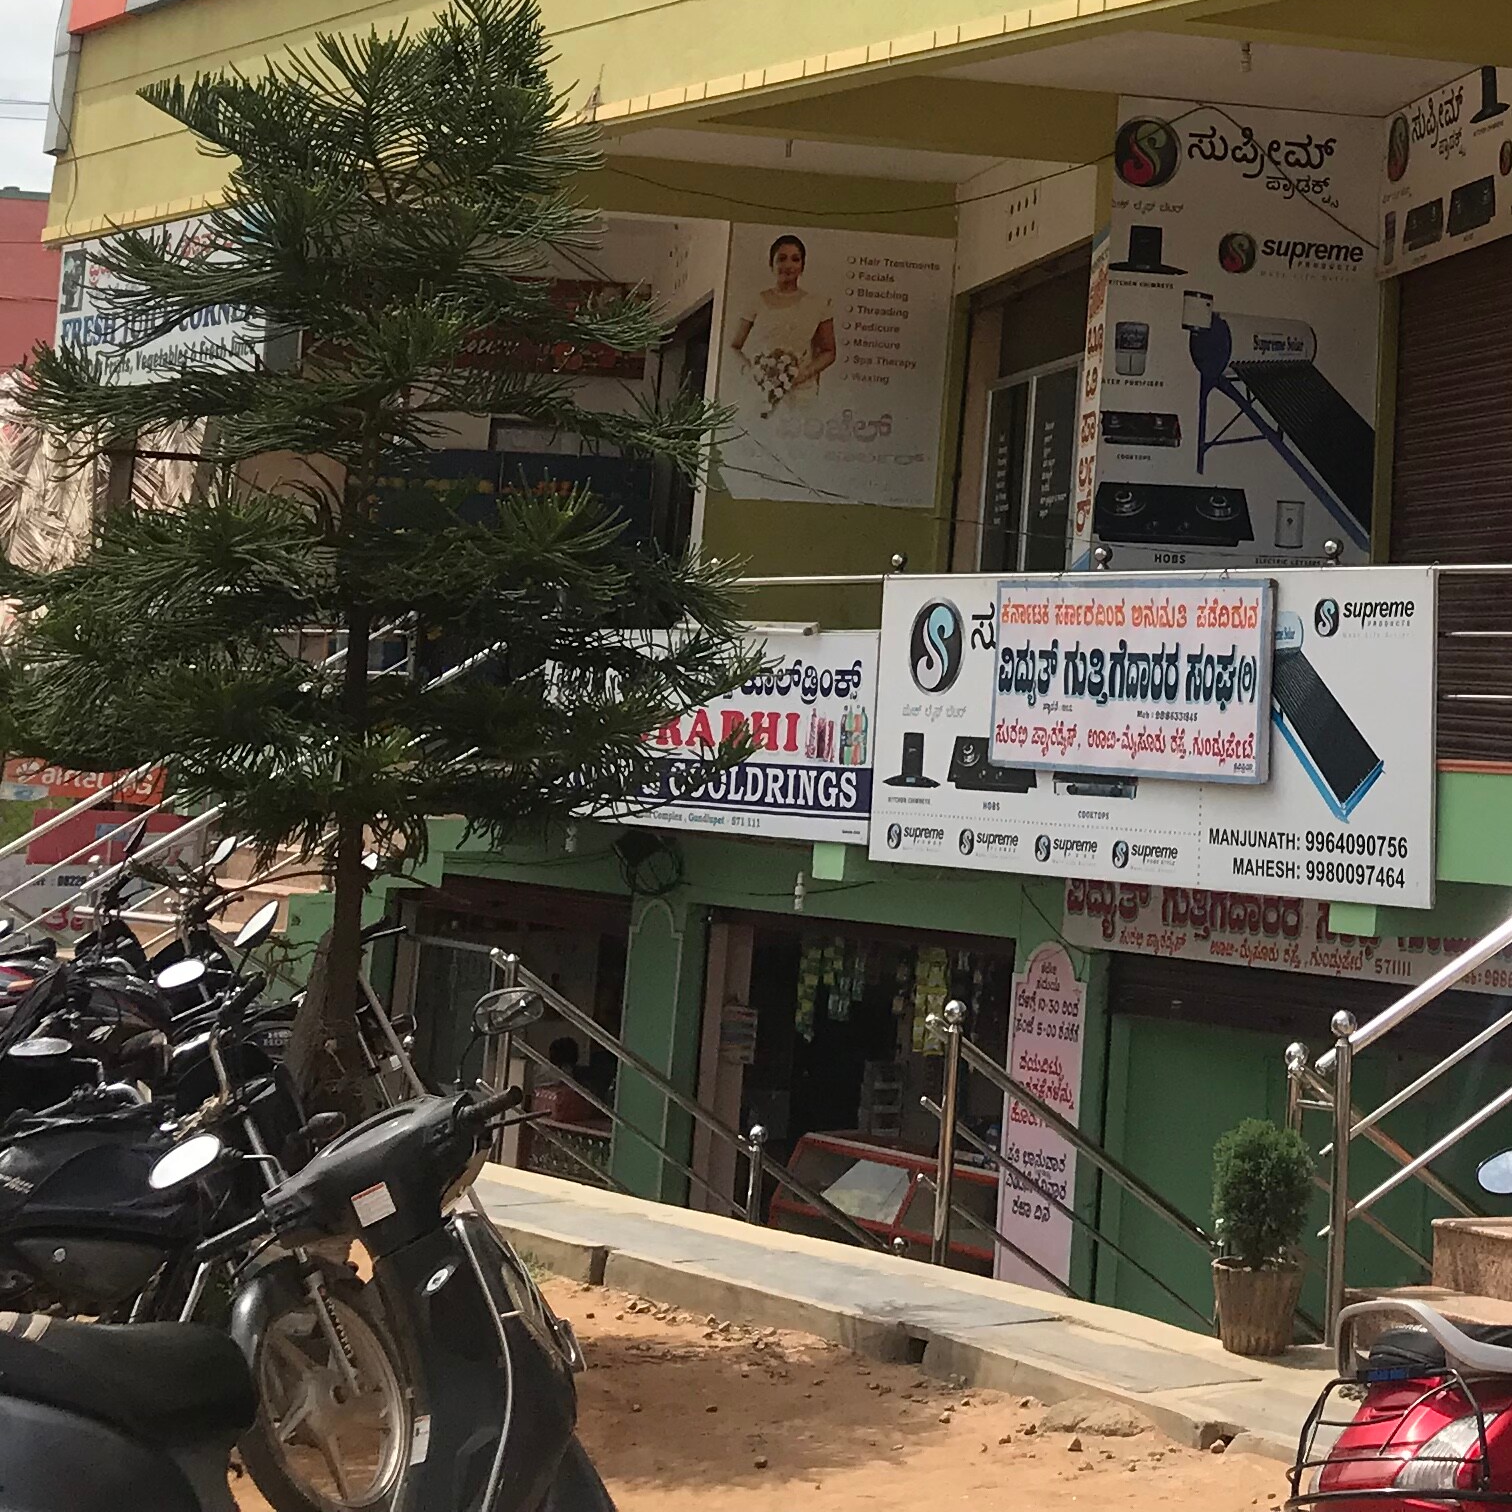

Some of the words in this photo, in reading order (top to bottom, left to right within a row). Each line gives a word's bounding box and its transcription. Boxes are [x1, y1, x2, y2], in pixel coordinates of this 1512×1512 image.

[1261, 238, 1364, 271] supreme
[858, 272, 895, 284] Facials
[857, 288, 909, 302] Bleaching
[62, 313, 116, 347] FRESH
[854, 321, 900, 334] Pedicure
[136, 345, 188, 372] Vegetables
[876, 355, 917, 370] Therapy
[1154, 554, 1187, 565] HOBS
[1130, 597, 1188, 628] ಅನುಮತಿ
[1342, 599, 1416, 630] supreme
[998, 638, 1059, 707] ವಿದ್ಯುತ್
[995, 717, 1028, 749] ಸುರಭಿ
[983, 801, 1001, 812] HOBS
[1078, 810, 1110, 821] COOKTOPS
[903, 825, 944, 845] supreme
[976, 832, 1019, 851] supreme
[1053, 838, 1098, 858] supreme
[1130, 843, 1178, 863] supreme
[1208, 827, 1301, 851] MANJUNATH:
[1304, 829, 1408, 859] 9964090756
[1232, 857, 1301, 880] MAHESH:
[1304, 859, 1406, 889] 9980097464
